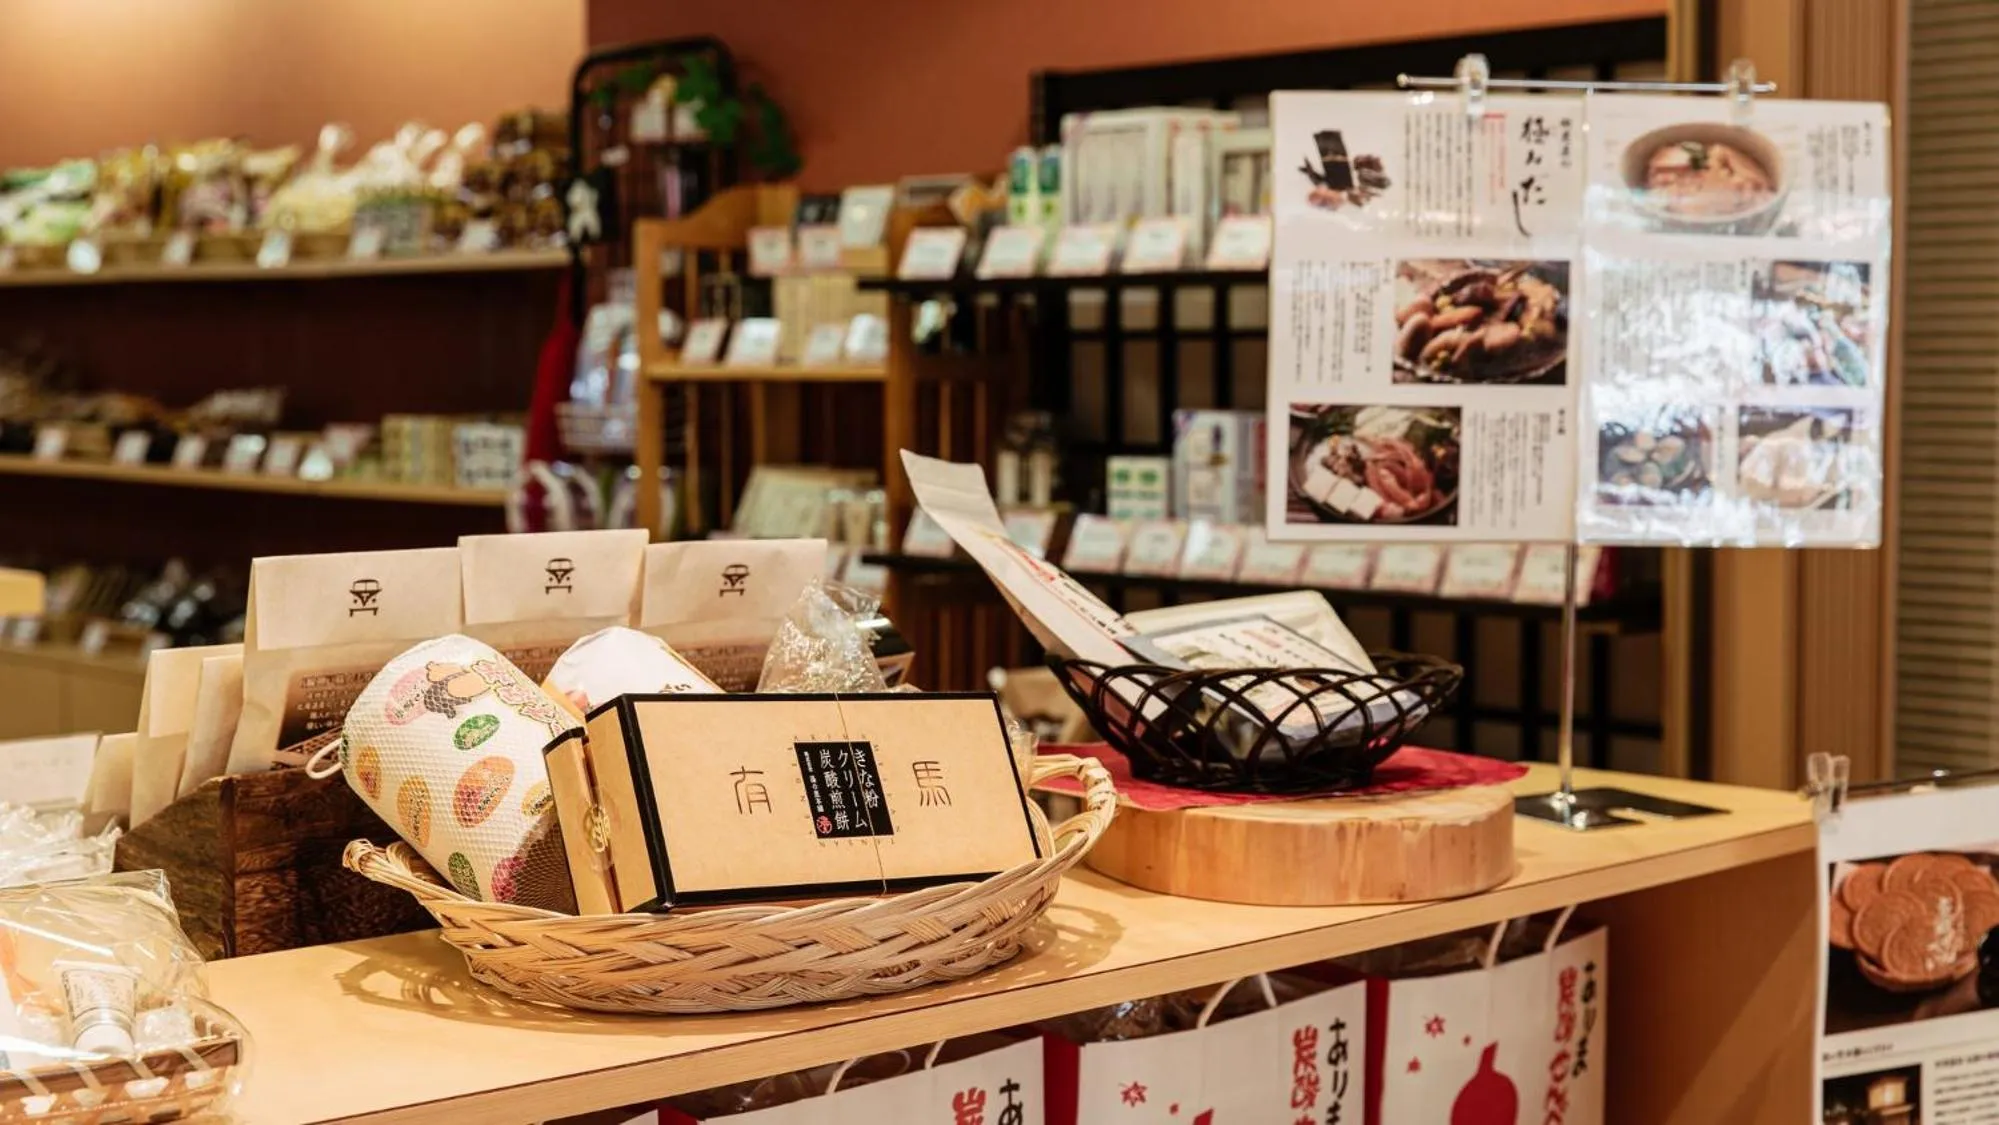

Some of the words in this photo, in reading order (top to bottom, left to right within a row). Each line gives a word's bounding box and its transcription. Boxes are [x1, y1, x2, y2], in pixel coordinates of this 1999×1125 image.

[729, 765, 772, 815] 有
[912, 760, 952, 807] 馬
[819, 749, 850, 831] 炭酸煎餅
[838, 749, 868, 829] クリーム
[854, 748, 881, 809] きな粉
